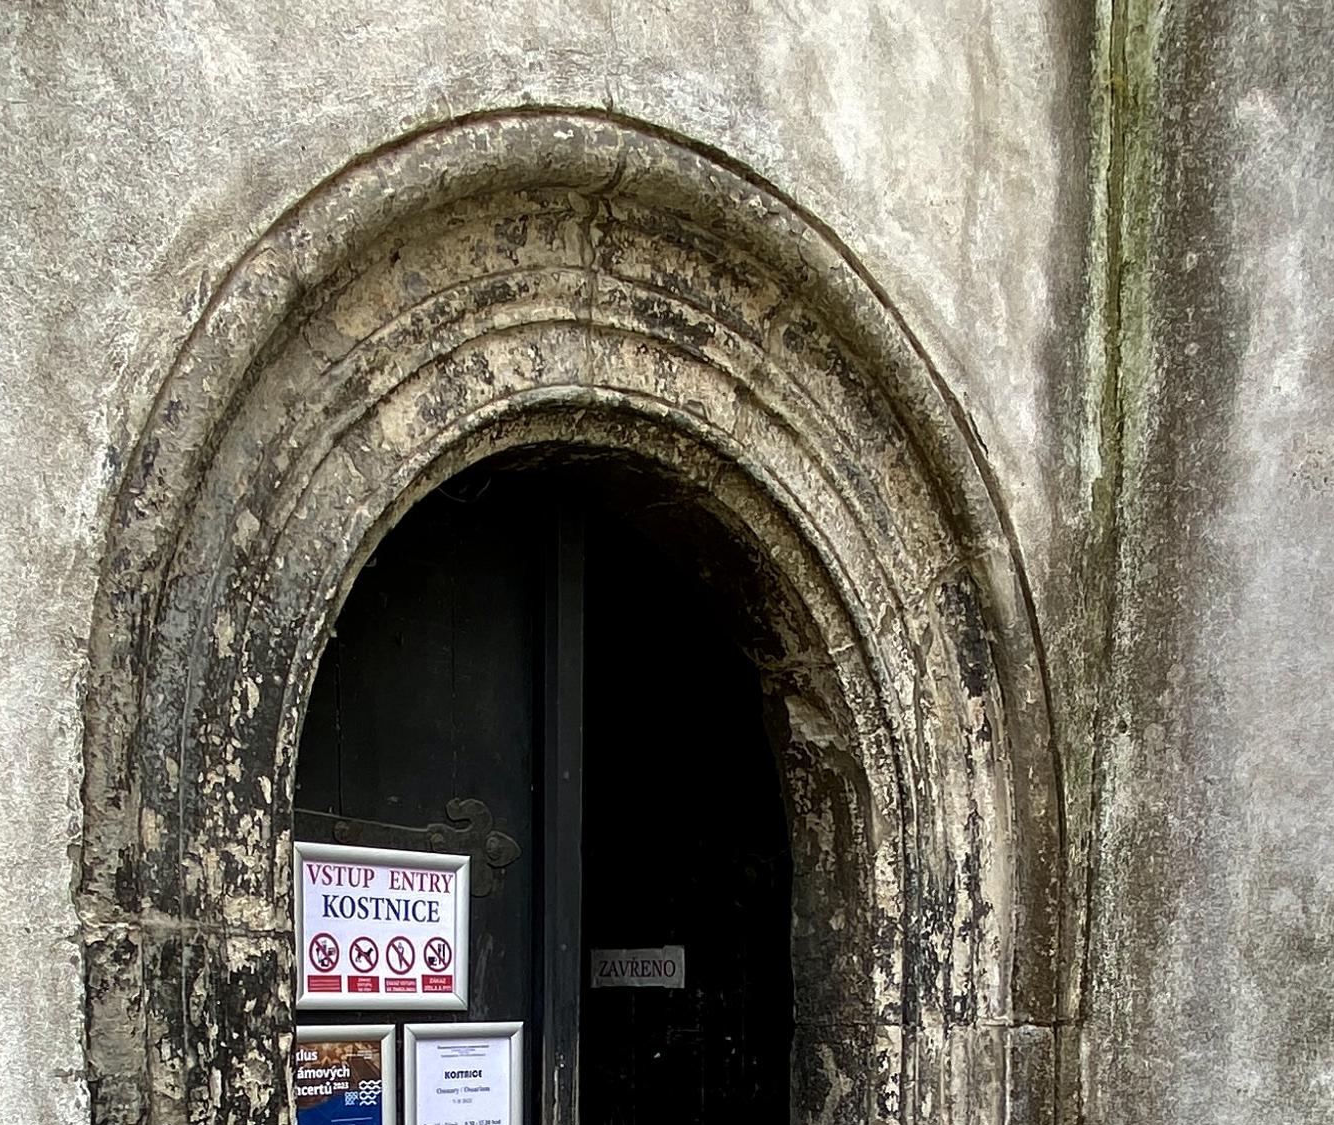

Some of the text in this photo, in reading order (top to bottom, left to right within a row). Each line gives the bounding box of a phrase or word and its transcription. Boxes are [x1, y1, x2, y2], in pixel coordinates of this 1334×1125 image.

[306, 864, 454, 893] VSTUP ENTRY
[322, 894, 440, 923] KOSTNICE
[598, 957, 676, 978] ZAVŘENO
